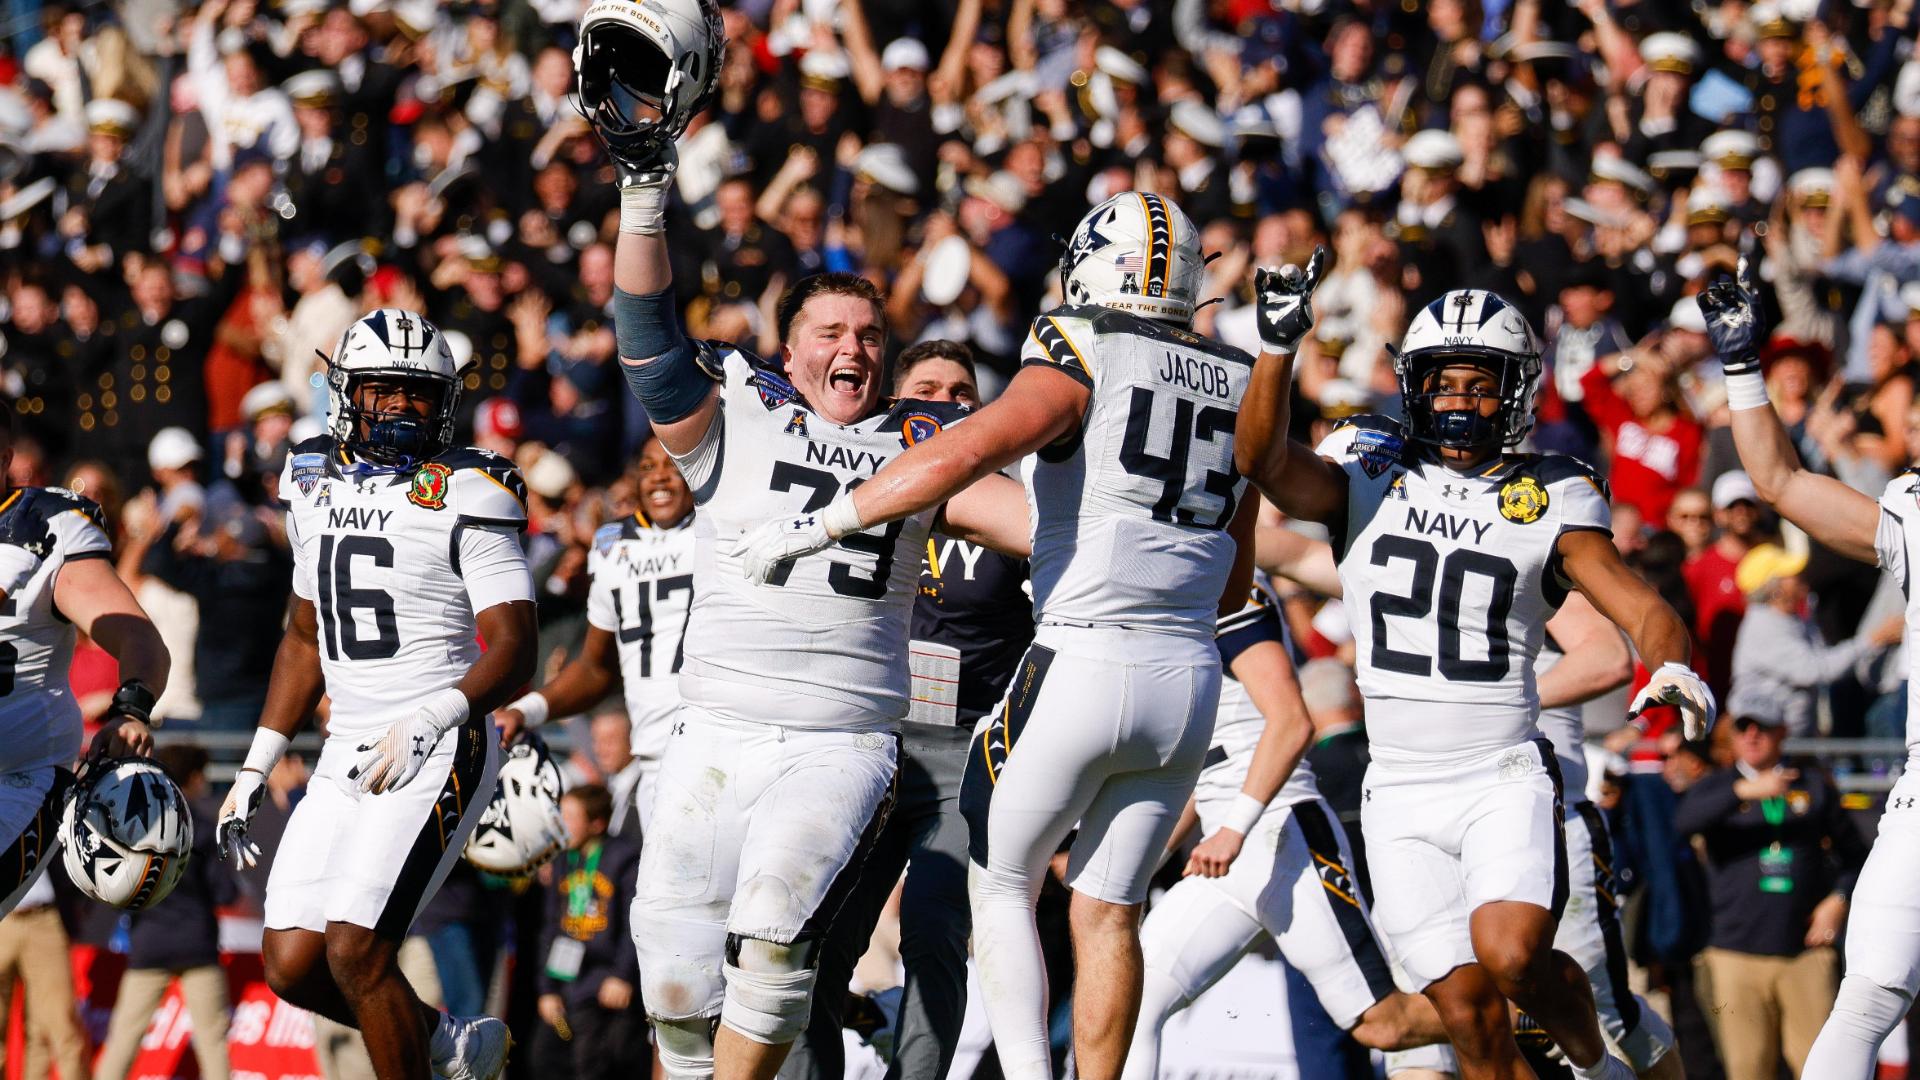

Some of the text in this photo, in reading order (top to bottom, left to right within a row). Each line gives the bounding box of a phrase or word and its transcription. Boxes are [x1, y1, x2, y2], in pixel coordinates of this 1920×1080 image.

[611, 5, 627, 13] THE
[630, 9, 660, 33] BONES
[1150, 283, 1161, 296] 43
[1105, 302, 1189, 318] FEAR THE BONES
[1444, 336, 1473, 346] NAVY
[392, 360, 419, 369] NAVY
[1160, 351, 1230, 399] JACOB
[806, 441, 887, 475] NAVY
[1119, 386, 1241, 531] 43
[328, 507, 394, 531] NAVY
[764, 460, 906, 600] 79
[1405, 507, 1493, 545] NAVY
[628, 552, 682, 578] NAVY
[317, 534, 401, 661] 16
[1370, 534, 1519, 681] 20
[611, 574, 694, 678] 47
